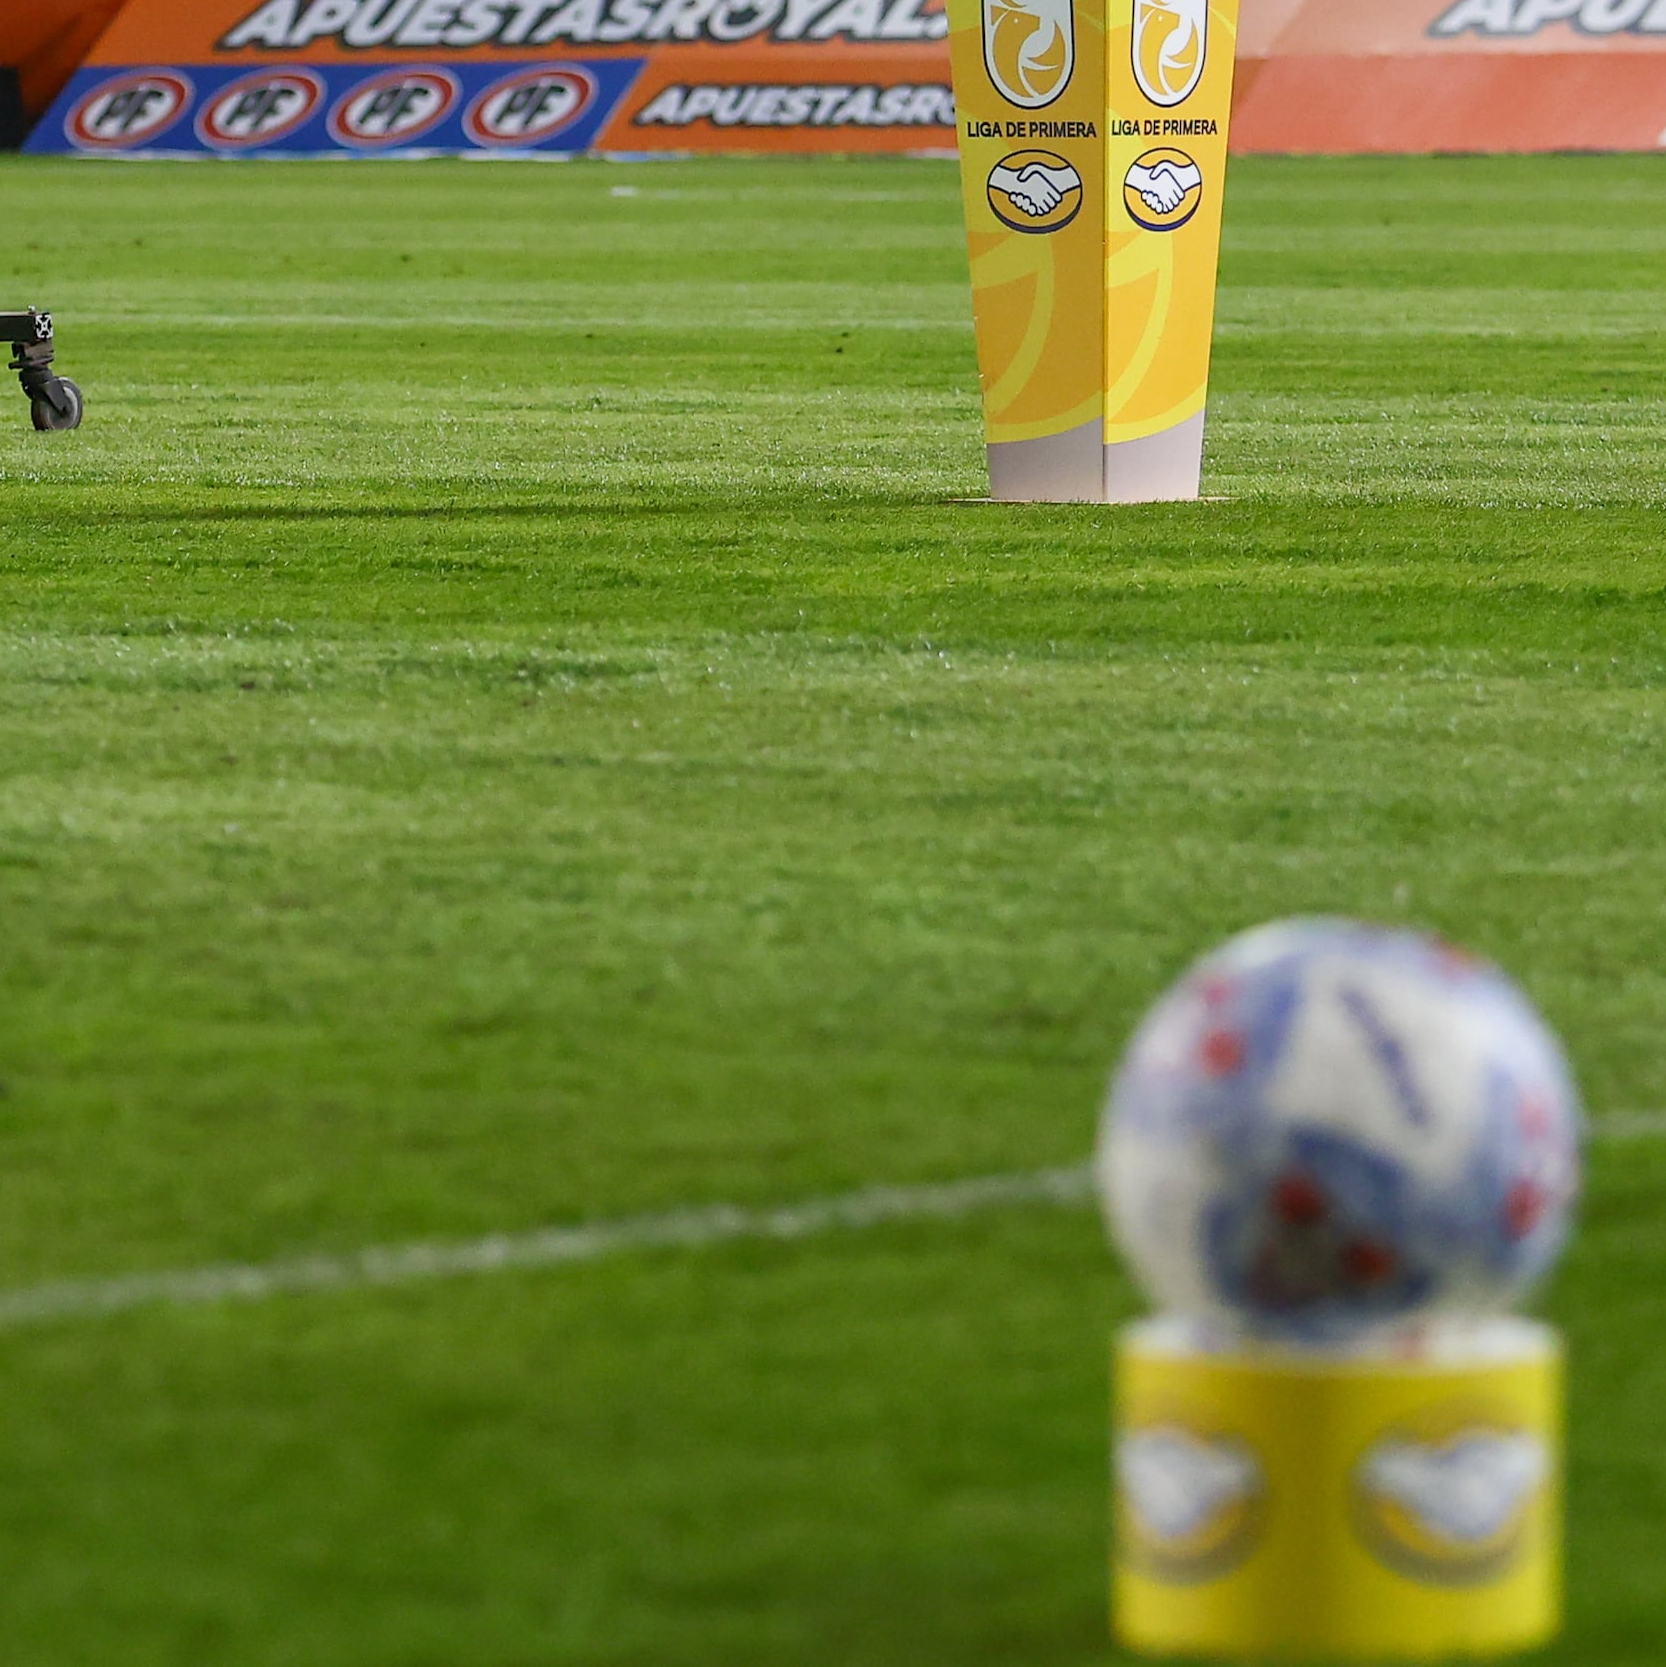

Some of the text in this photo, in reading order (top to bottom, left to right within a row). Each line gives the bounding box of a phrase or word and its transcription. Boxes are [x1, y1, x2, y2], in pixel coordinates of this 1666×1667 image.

[966, 120, 1097, 139] LIGA DE PRIMERA
[1111, 118, 1218, 136] LIGA DE PRIMERA
